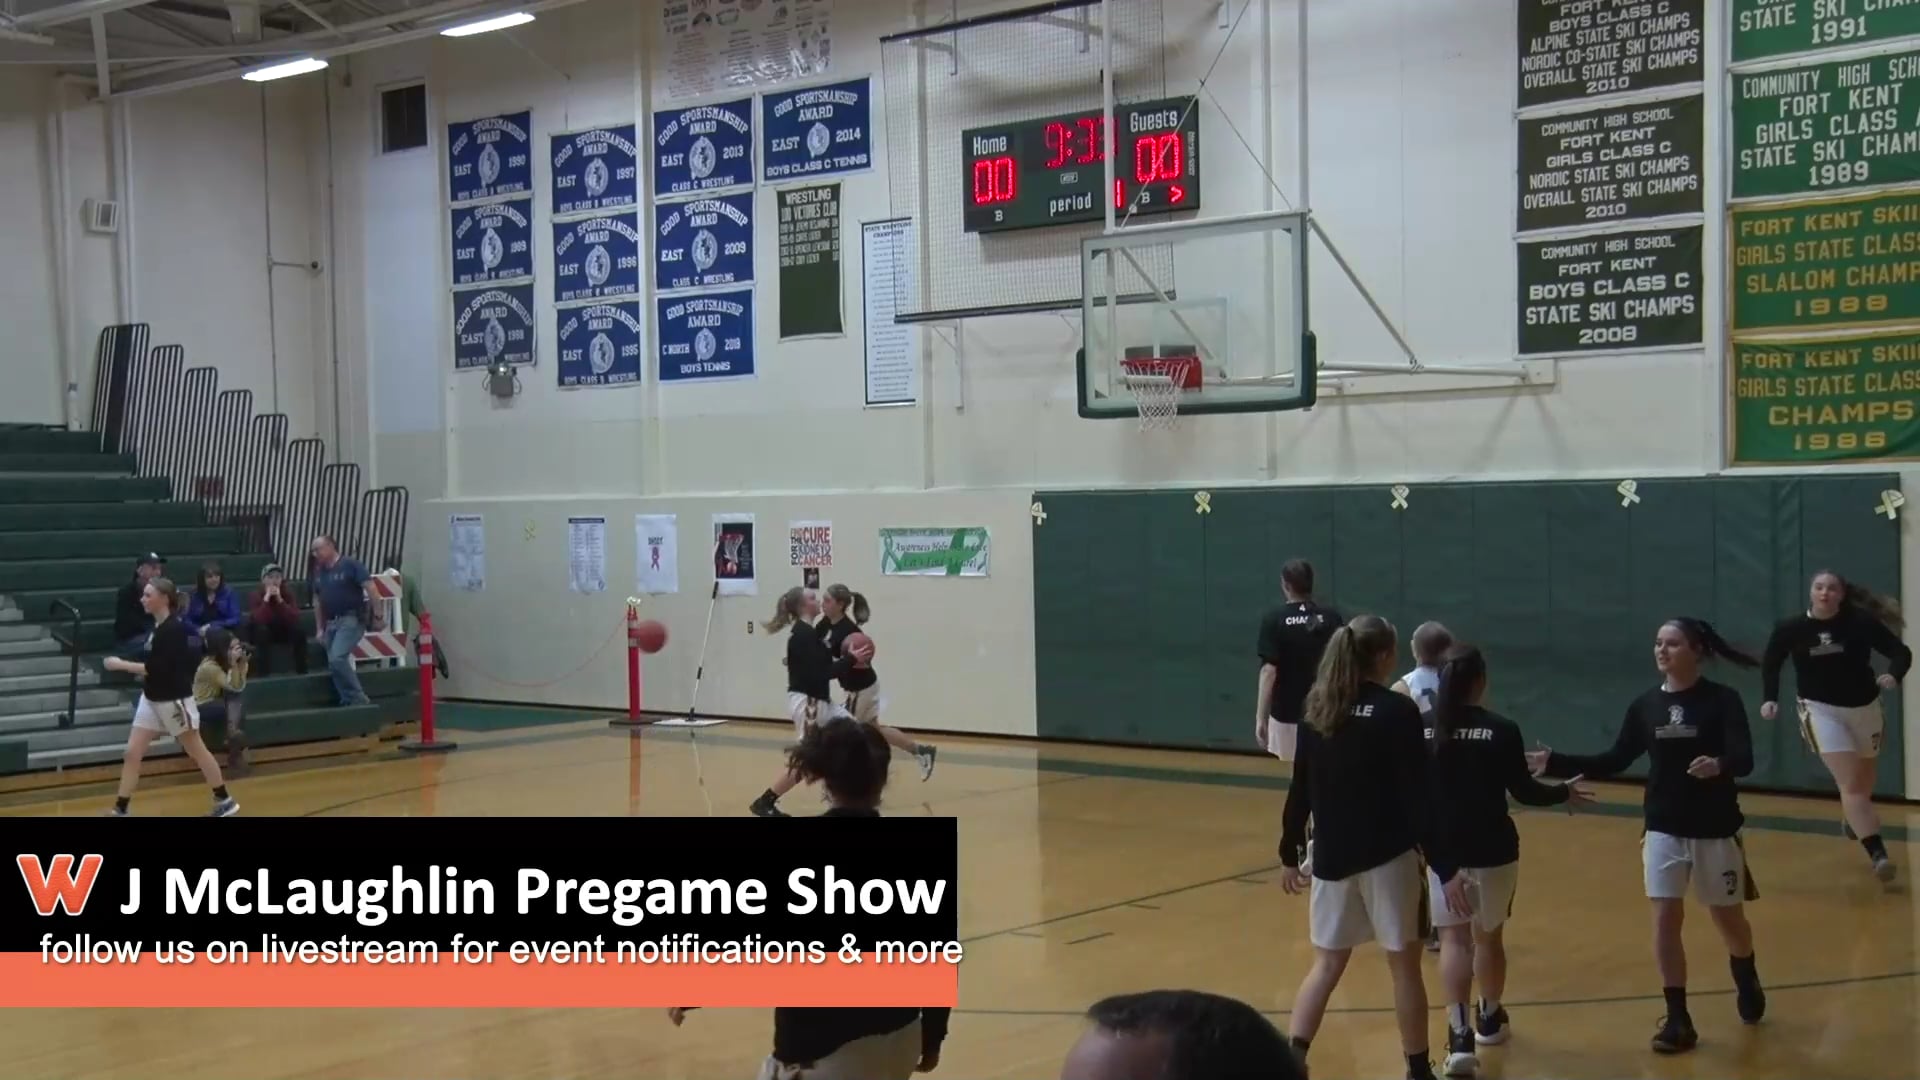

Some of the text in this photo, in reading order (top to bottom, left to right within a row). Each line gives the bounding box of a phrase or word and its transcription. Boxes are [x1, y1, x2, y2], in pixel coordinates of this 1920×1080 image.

[1550, 14, 1592, 32] BOYS
[1597, 4, 1651, 24] CLASS
[1657, 1, 1670, 14] C
[1740, 3, 1796, 32] STATE
[1813, 0, 1846, 20] SKI
[1531, 12, 1690, 53] ALPINE STATE SKI CHAMPS
[1812, 16, 1867, 44] 1991
[1522, 29, 1700, 73] NORDIC CO-STATE SKI CHAMPS
[1524, 48, 1697, 89] OVERALL STATE SKI CHAMPS
[1743, 56, 1920, 99] COMMUNITY HIGH SCH
[1586, 76, 1630, 94] 2010
[795, 90, 858, 107] SPORTSMANSHIP
[1780, 83, 1903, 118] FORT KENT
[658, 107, 749, 146] GOOD SPORTSMANSHIP
[798, 105, 833, 122] AWARD
[1541, 107, 1675, 136] COMMUNITY HIGH SCHOOL
[1756, 108, 1897, 145] GIRLS CLASS
[689, 121, 717, 136] AWARD
[772, 127, 861, 152] EAST 2014
[973, 136, 1007, 156] Home
[1130, 109, 1178, 133] Guests
[1560, 126, 1656, 150] FORT KENT
[554, 130, 638, 168] GOOD SPORTSMANSHIP
[583, 142, 609, 157] AWARD
[661, 145, 744, 167] EAST 2013
[1547, 141, 1672, 168] GIRLS CLASS C
[1740, 130, 1920, 169] STATE SKI CHAM
[454, 163, 472, 176] EAST
[557, 166, 635, 188] EAST 1997
[767, 154, 868, 177] BOYS CLASS C TENNIS
[974, 157, 1014, 204] 00
[1136, 134, 1180, 183] 00
[1529, 155, 1690, 190] NORDIC STATE SKI CHAMPS
[1809, 160, 1869, 186] 1989
[672, 181, 691, 192] CLASS
[701, 175, 734, 188] WRESTLING
[785, 188, 831, 205] WRESTLING
[1524, 175, 1697, 210] OVERALL STATE SKI CHAMPS
[660, 200, 748, 236] GOOD SPORTSMANSHIP
[995, 210, 1004, 222] B
[1050, 192, 1092, 217] period
[1141, 192, 1151, 204] B
[1585, 203, 1627, 219] 2010
[690, 213, 718, 228] AWARD
[1741, 217, 1794, 237] FORT
[1804, 210, 1863, 232] KENT
[556, 218, 639, 256] GOOD SPORTSMANSHIP
[584, 231, 610, 244] AWARD
[1541, 235, 1675, 260] COMMUNITY HIGH SCHOOL
[1736, 231, 1920, 266] GIRLS STATE CLAS
[456, 247, 476, 260] EAST
[661, 241, 746, 262] EAST 2009
[559, 264, 579, 276] EAST
[1559, 256, 1657, 277] FORT KENT
[1529, 272, 1690, 300] BOYS CLASS C
[1747, 268, 1835, 294] SLALOM
[471, 291, 533, 326] SPORTSMANSHIP
[686, 299, 744, 317] SPORTSMANSHIP
[1526, 295, 1695, 325] STATE SKI CHAMPS
[1795, 294, 1888, 317] 1988
[582, 305, 640, 333] SPORTSMANSHIP
[688, 314, 721, 328] AWARD
[461, 332, 484, 345] EAST
[1579, 326, 1637, 345] 2008
[563, 349, 583, 361] EAST
[681, 361, 731, 374] BOYS TENNIS
[1741, 343, 1920, 370] FORT KENT SKII
[1737, 377, 1786, 398] GIRLS
[1795, 374, 1856, 397] STATE
[1769, 400, 1914, 426] CHAMPS
[803, 526, 831, 544] CURE
